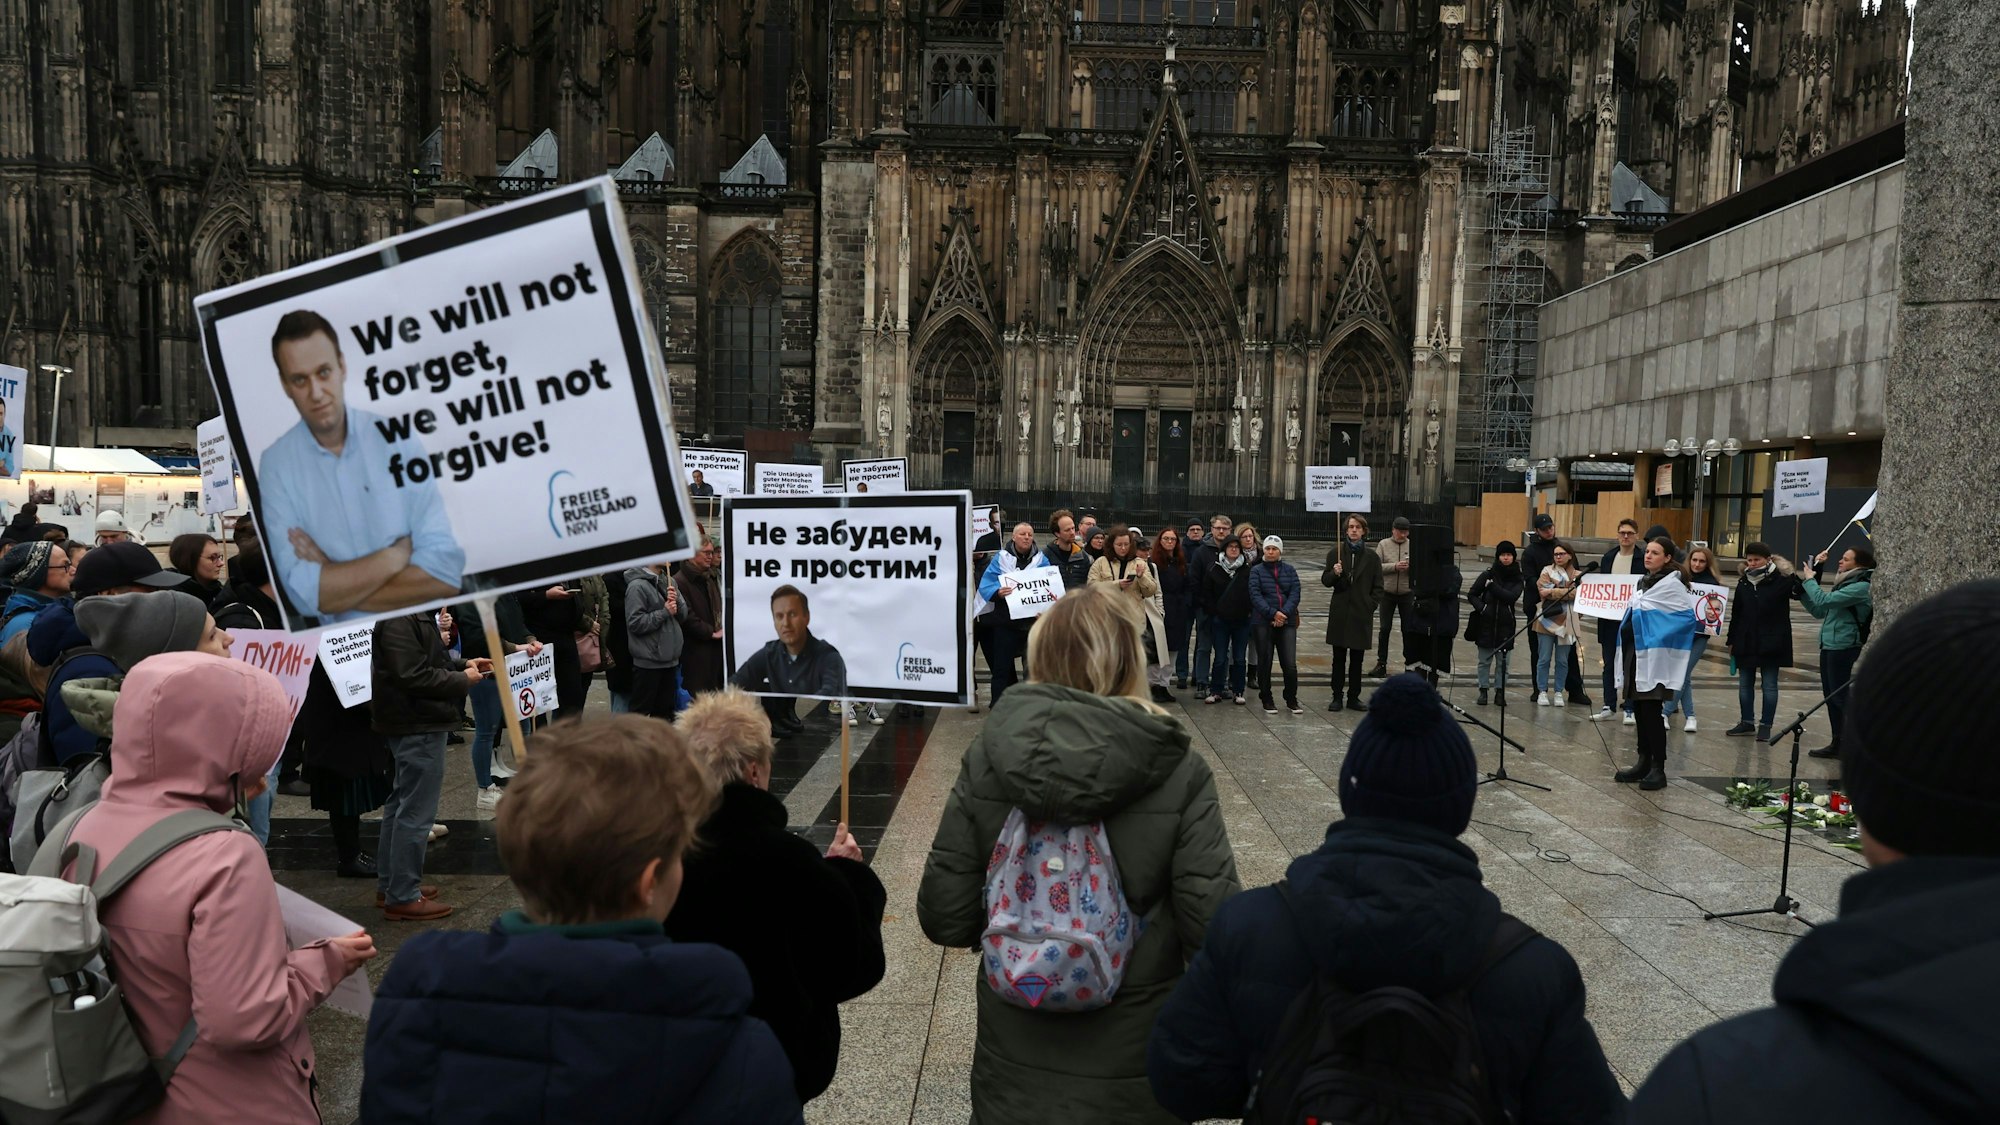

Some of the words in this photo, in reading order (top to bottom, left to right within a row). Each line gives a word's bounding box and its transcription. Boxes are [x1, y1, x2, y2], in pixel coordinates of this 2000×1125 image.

[350, 315, 421, 355] We
[430, 282, 510, 334] will
[519, 262, 598, 311] not
[364, 341, 507, 401] forget,
[374, 408, 437, 444] we
[446, 376, 525, 426] will
[536, 359, 612, 405] not
[388, 420, 550, 488] forgive!
[699, 455, 741, 464] забудем,
[862, 472, 900, 481] простим!
[863, 465, 901, 473] забудем,
[559, 487, 610, 509] FREIES
[563, 496, 637, 522] RUSSLAND
[566, 519, 598, 536] NRW
[747, 521, 787, 546] Не
[796, 519, 942, 551] забудем,
[745, 559, 781, 578] не
[791, 555, 937, 584] простим!
[1017, 579, 1050, 591] PUTIN
[1021, 594, 1054, 606] KILLER
[1579, 599, 1607, 609] OHNE
[330, 639, 370, 656] zwischen
[334, 654, 352, 665] und
[509, 653, 551, 677] UsurPutin
[904, 657, 932, 666] FREIES
[904, 665, 946, 675] RUSSLAND
[511, 676, 533, 692] muss
[534, 667, 552, 683] weg!
